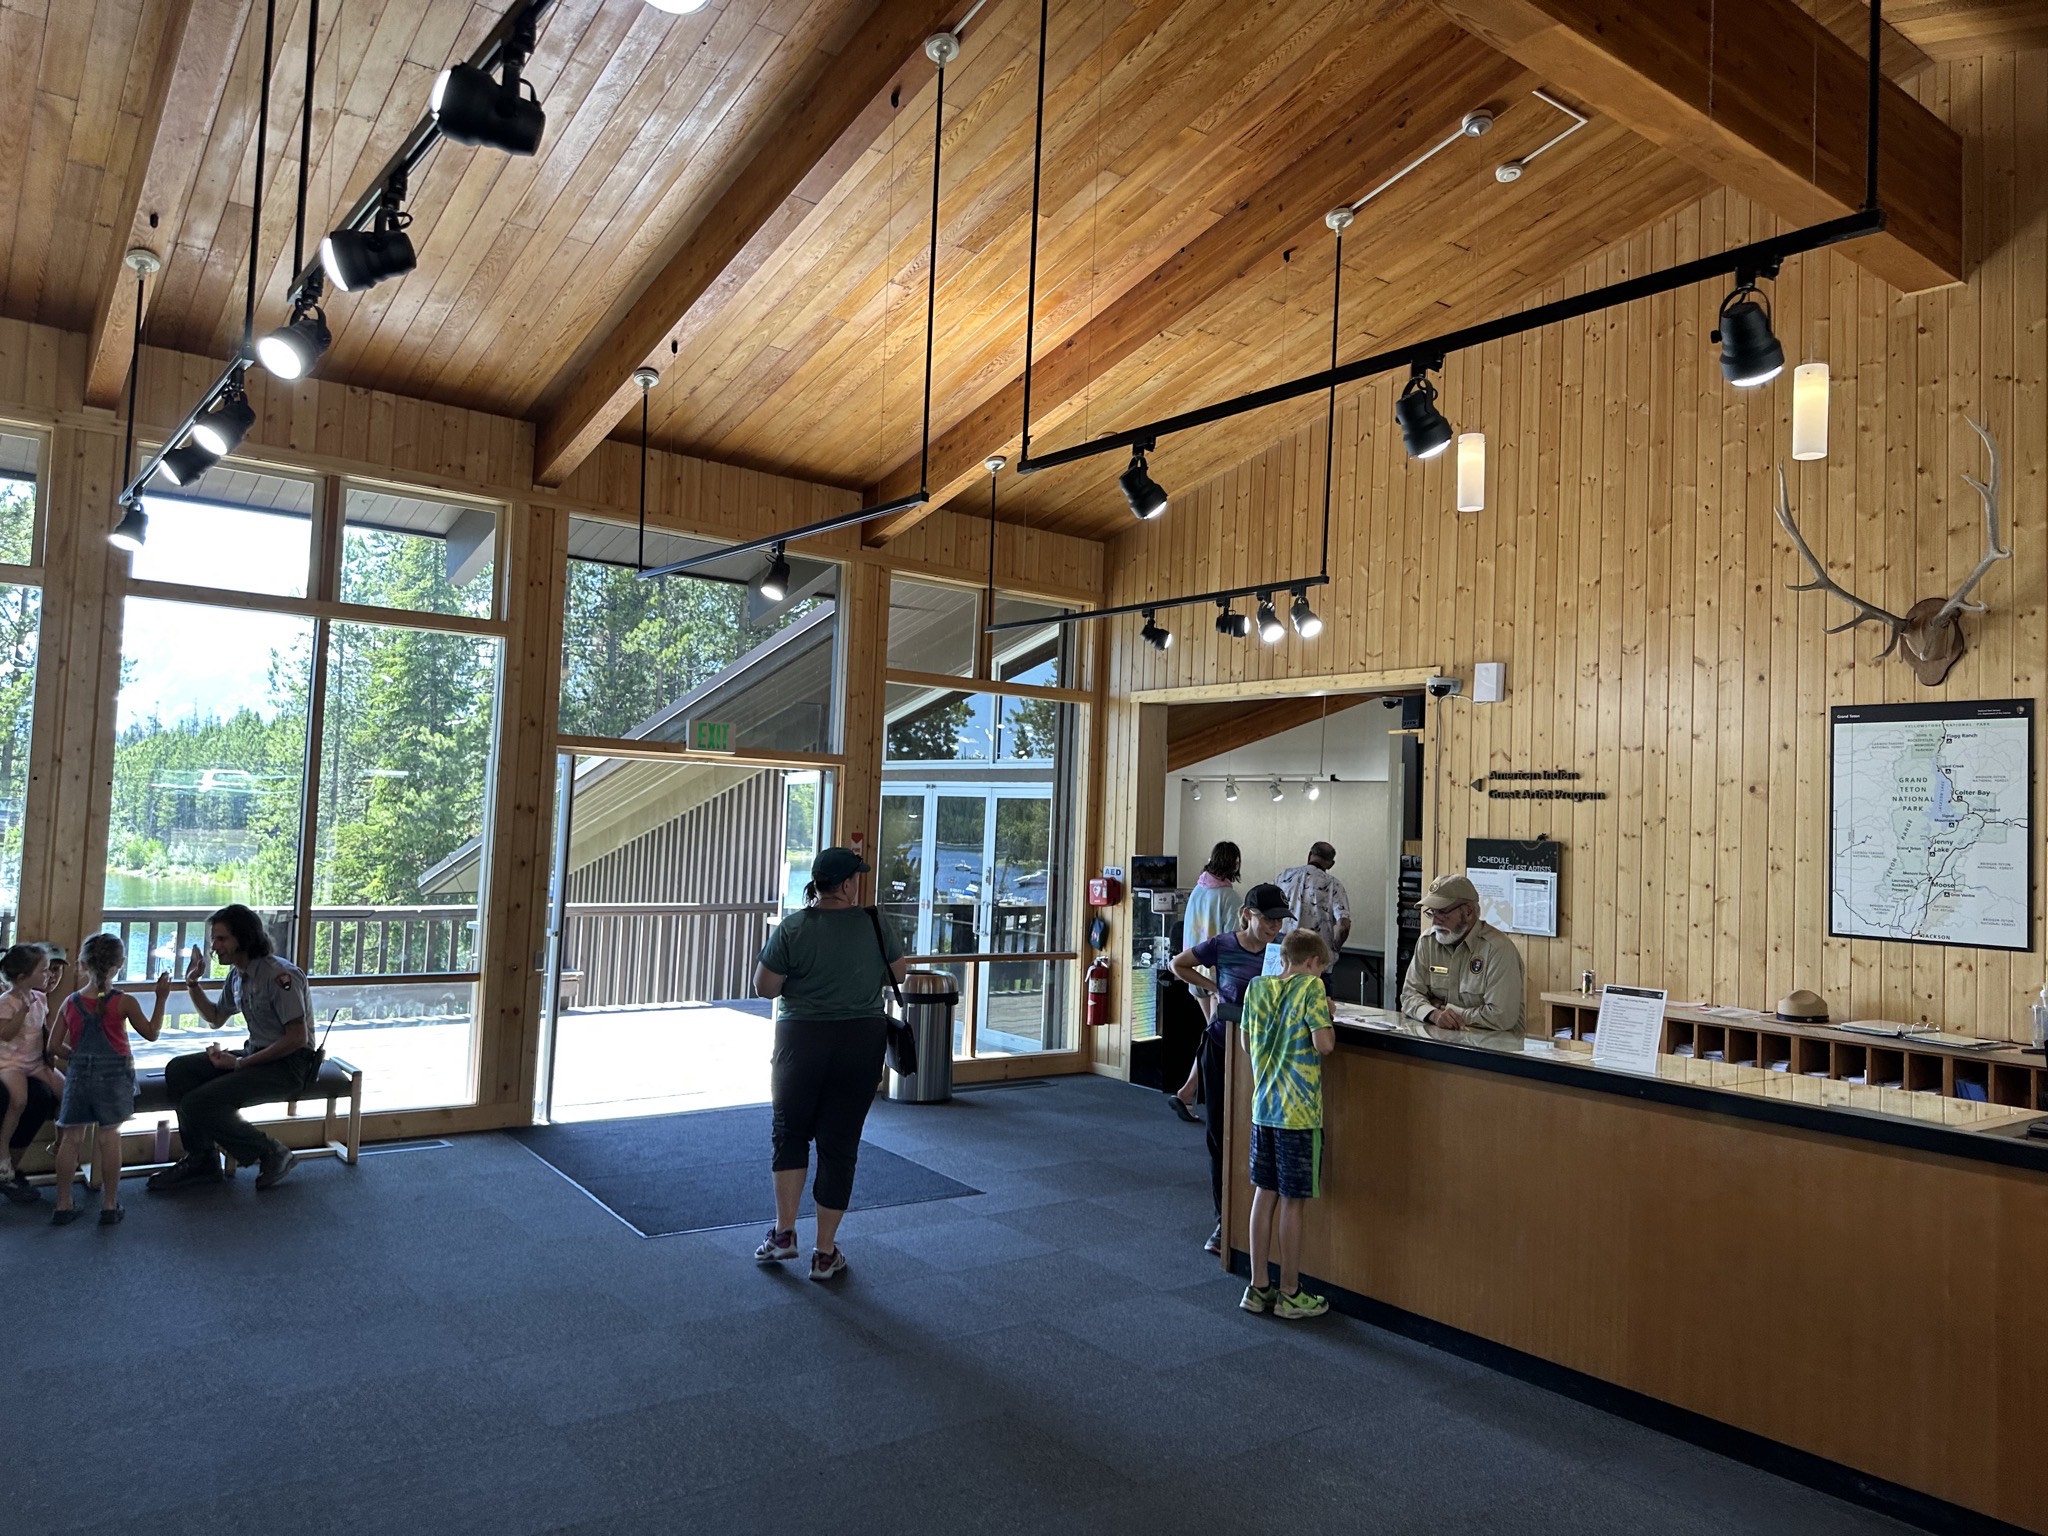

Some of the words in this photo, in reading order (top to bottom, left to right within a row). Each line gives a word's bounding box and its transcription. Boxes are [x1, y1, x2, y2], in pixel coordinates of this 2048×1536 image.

[697, 722, 730, 750] EXIT
[1489, 769, 1542, 780] American
[1543, 769, 1581, 780] Indian
[1488, 789, 1520, 800] Guest
[1521, 789, 1554, 800] Artist
[1555, 789, 1606, 802] Program
[1977, 789, 1991, 797] Bay
[1933, 839, 1954, 847] Jenny
[1886, 857, 1898, 878] TETON
[1901, 819, 1913, 840] RANGE
[1477, 855, 1510, 865] SCHEDULE
[1104, 868, 1122, 876] AED
[1506, 864, 1527, 872] GUEST
[1527, 865, 1552, 873] ARTISTS
